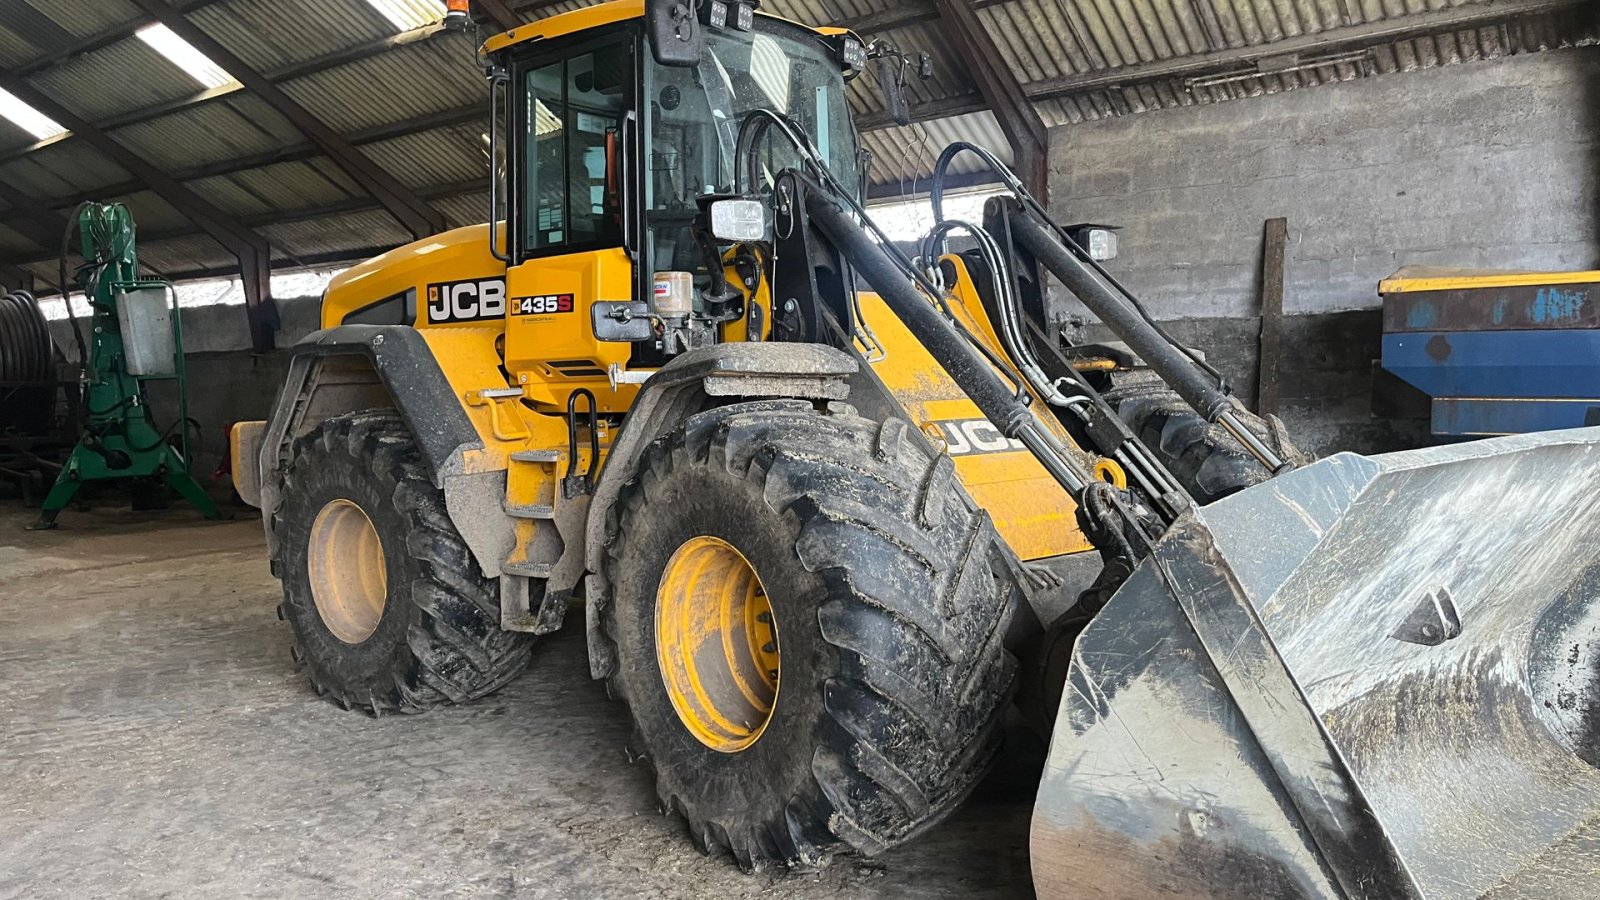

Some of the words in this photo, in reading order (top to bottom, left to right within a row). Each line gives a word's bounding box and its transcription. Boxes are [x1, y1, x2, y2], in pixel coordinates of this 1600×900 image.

[430, 280, 505, 320] JCB
[521, 295, 571, 313] 435S
[942, 420, 1026, 454] JC
